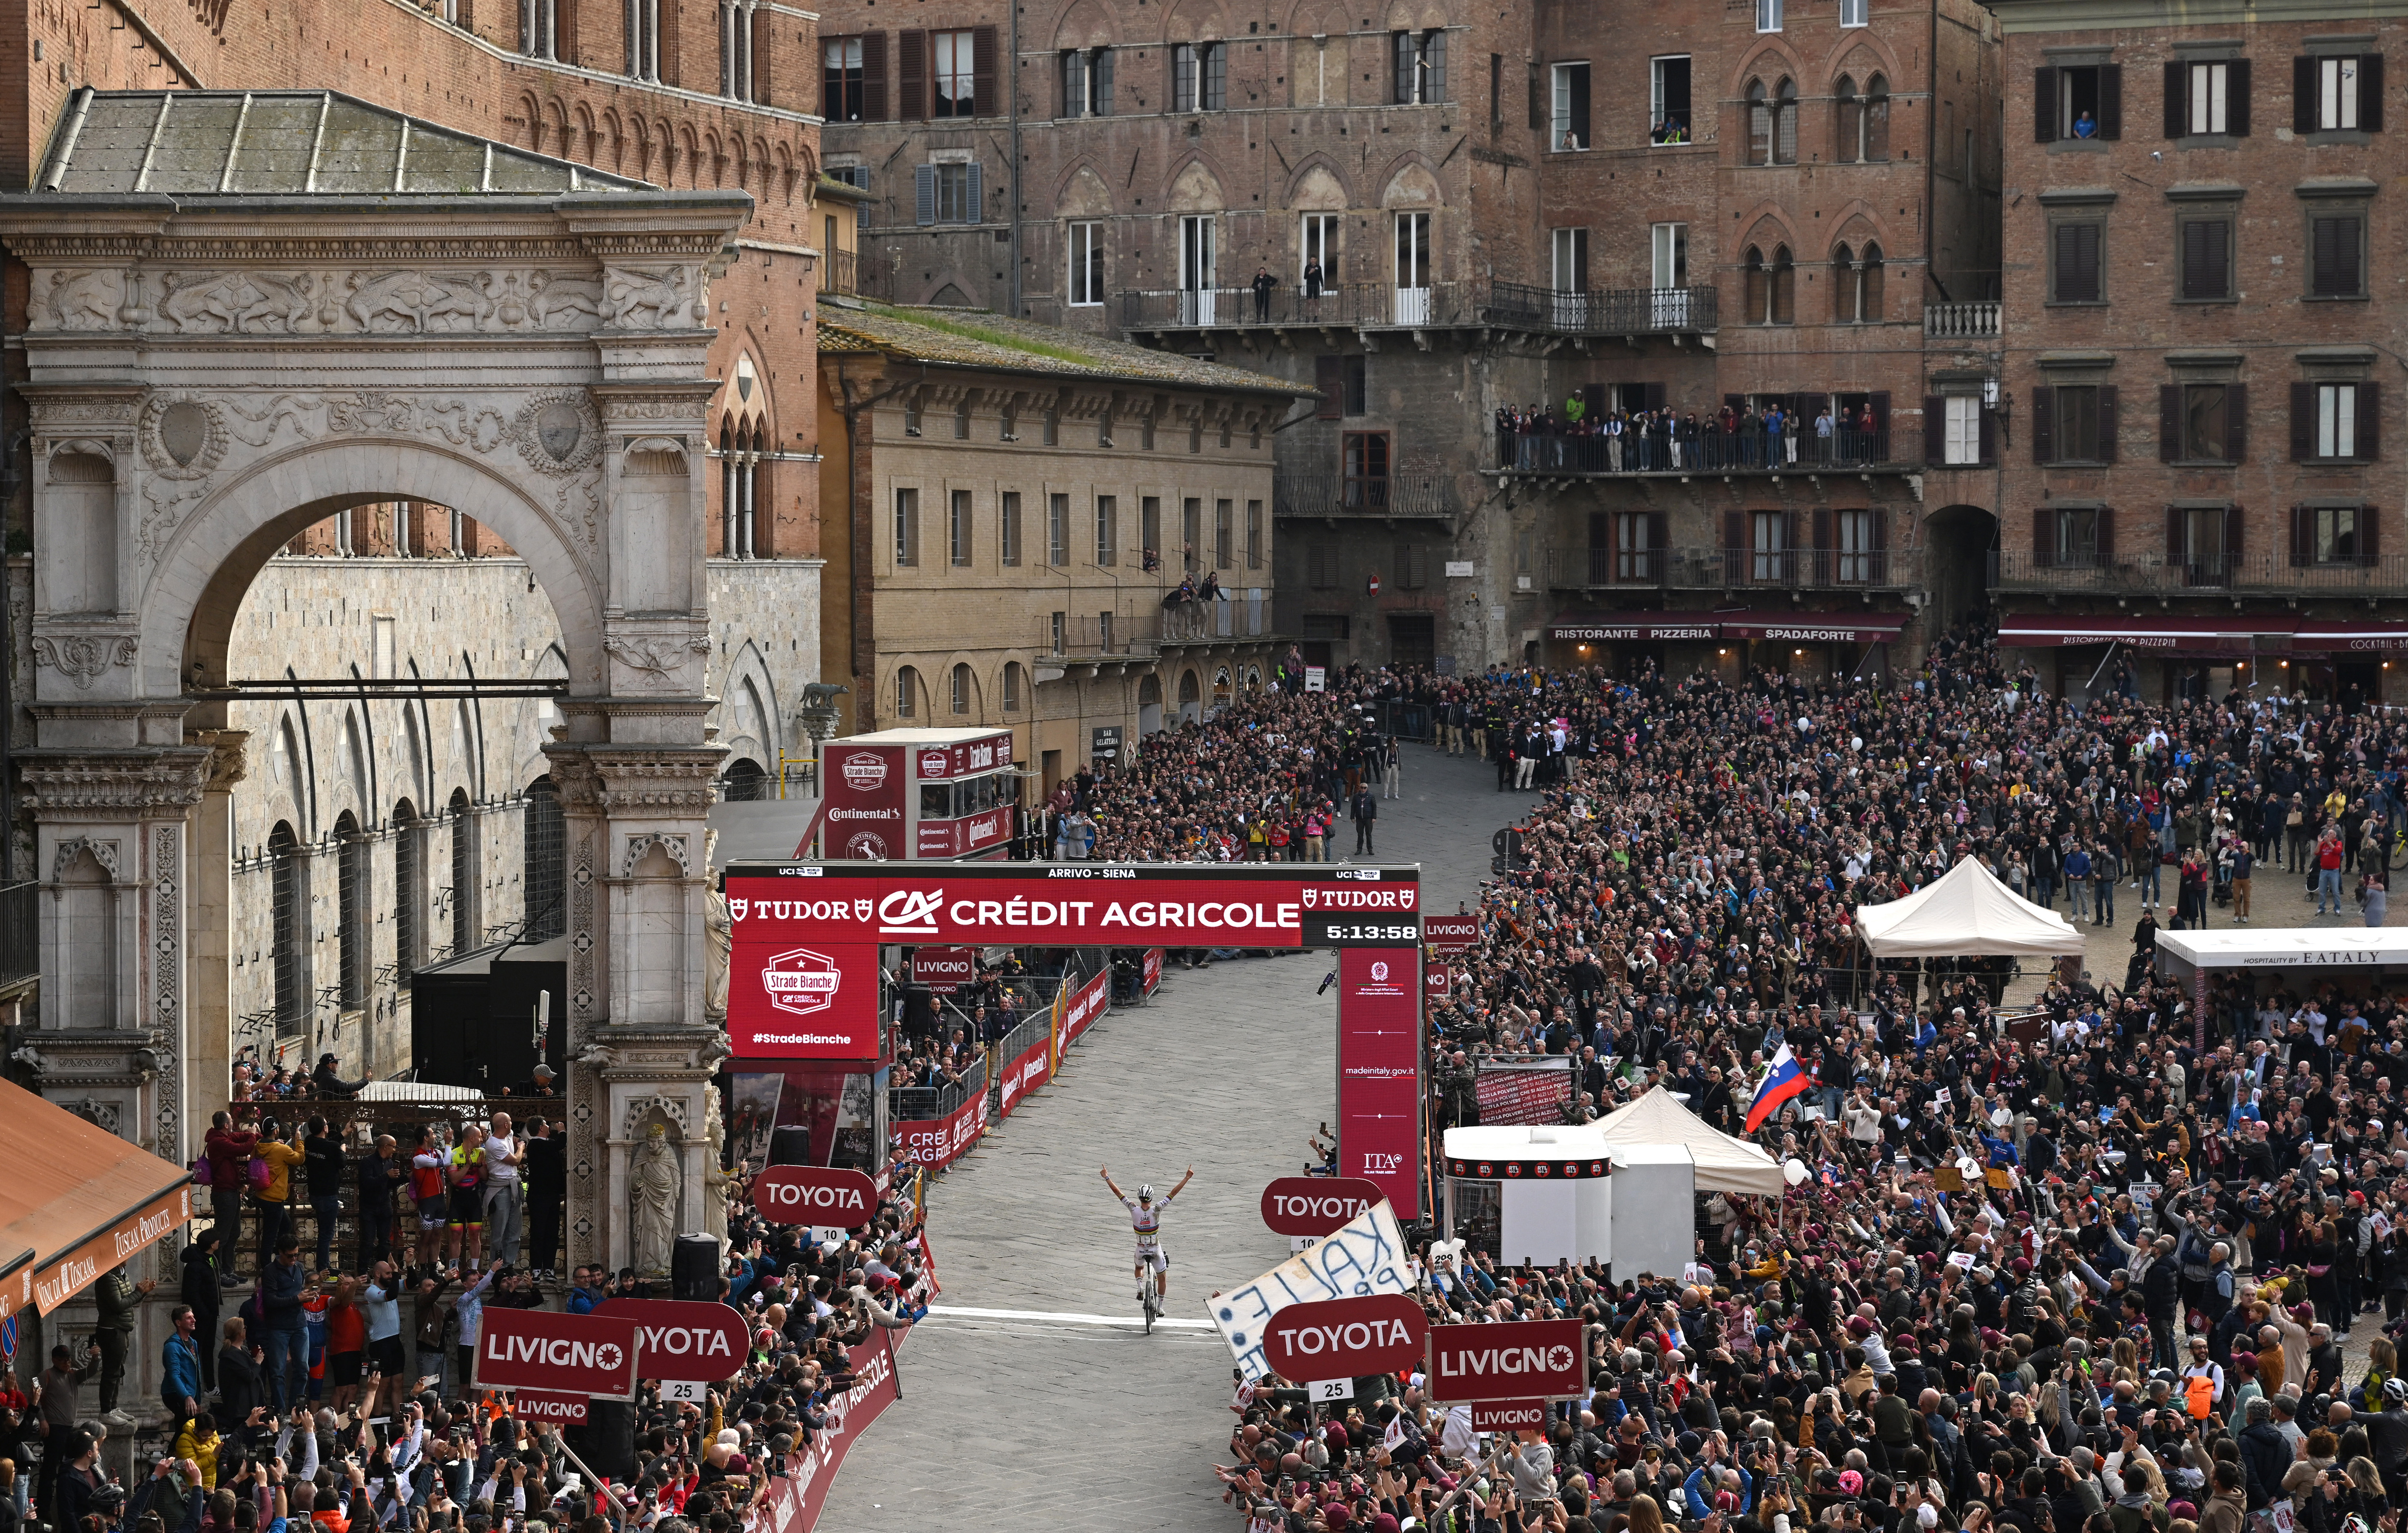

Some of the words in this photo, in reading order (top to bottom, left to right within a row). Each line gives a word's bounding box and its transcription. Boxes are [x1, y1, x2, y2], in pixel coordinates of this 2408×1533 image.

[1555, 630, 1638, 638] RISTORANTE
[1651, 629, 1711, 638] PIZZERIA
[1766, 630, 1854, 641] SPADAFORTE
[2140, 638, 2176, 647] PIZZERIA
[1214, 668, 1231, 687] TABACCHI
[847, 768, 862, 776] Strade
[863, 768, 883, 776] Bianche
[828, 808, 891, 821] Continental
[970, 817, 995, 847] Continental
[849, 832, 884, 849] CONTINENTAL
[1048, 869, 1091, 878] ARRIVO
[1103, 869, 1136, 878] SIENA
[1322, 891, 1397, 907] TUDOR
[754, 900, 850, 920] TUDOR
[950, 895, 1093, 926] CRÉDIT
[1101, 903, 1300, 927] AGRICOLE
[1327, 926, 1417, 940] 5:13:58
[1427, 925, 1475, 935] LIVIGNO
[2173, 940, 2188, 959] EATALY
[2303, 951, 2380, 963] EATALY
[917, 961, 968, 972] LIVIGNO
[771, 975, 799, 988] Strade
[801, 975, 832, 988] Bianche
[753, 1033, 851, 1045] #StradeBianche
[1346, 1066, 1414, 1076] madeinitaly.gov.it
[1497, 1081, 1517, 1089] POLVERE
[1498, 1086, 1518, 1095] POLVERE
[1552, 1074, 1571, 1082] POLVERE
[961, 1108, 973, 1129] CRÉDIT
[909, 1128, 948, 1146] CRÉDIT
[960, 1120, 976, 1144] AGRICOLE
[911, 1141, 951, 1162] AGRICOLE
[1364, 1154, 1396, 1168] ITA
[1965, 1160, 1974, 1173] 299
[766, 1183, 864, 1210] TOYOTA
[1274, 1196, 1370, 1219] TOYOTA
[114, 1226, 140, 1258] TUSCAN
[139, 1208, 170, 1242] PRODUCTS
[824, 1230, 837, 1240] 10
[1149, 1236, 1152, 1244] 1
[1301, 1239, 1314, 1248] 10
[1434, 1254, 1453, 1265] 299
[37, 1277, 54, 1309] VINI
[52, 1279, 62, 1300] DI
[68, 1255, 97, 1289] TOSCANA
[639, 1326, 731, 1356] YOTA
[1278, 1318, 1412, 1356] TOYOTA
[488, 1334, 623, 1371] LIVIGNO
[1441, 1345, 1574, 1377] LIVIGNO
[674, 1385, 692, 1398] 25
[1325, 1383, 1343, 1398] 25
[518, 1399, 586, 1419] LIVIGNO
[1475, 1408, 1543, 1425] LIVIGNO
